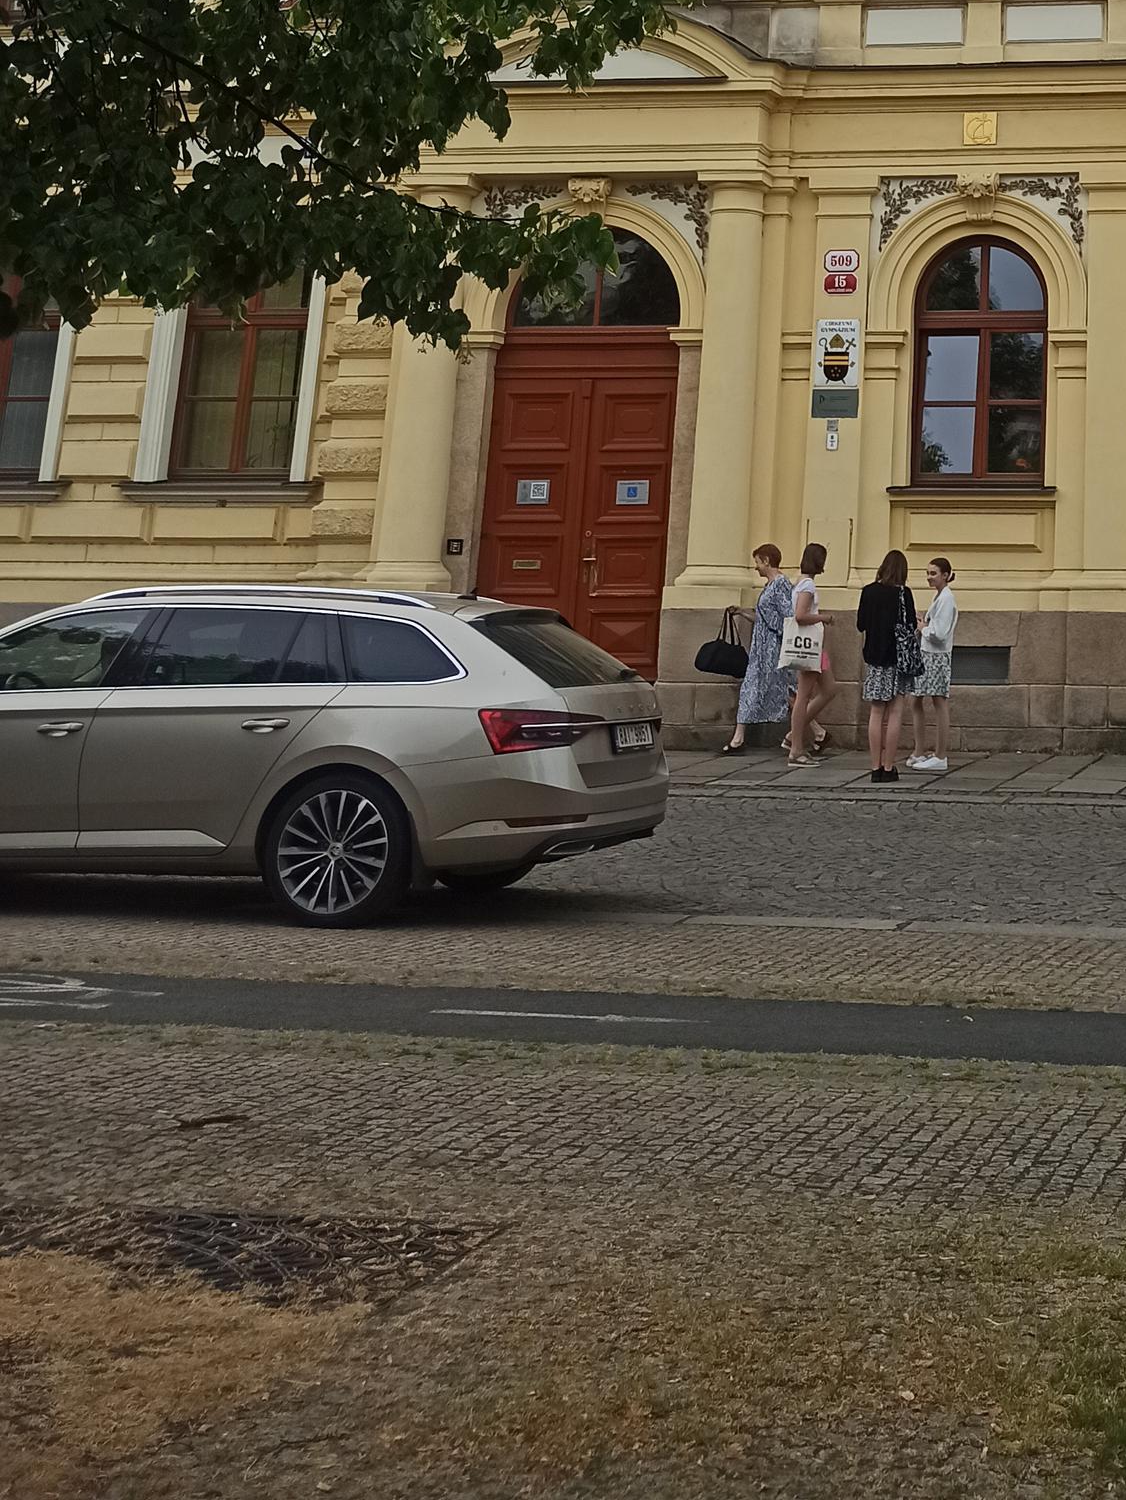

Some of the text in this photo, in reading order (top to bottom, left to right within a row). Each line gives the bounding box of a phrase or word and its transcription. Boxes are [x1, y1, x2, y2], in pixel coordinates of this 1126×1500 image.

[830, 254, 852, 267] 509
[834, 275, 847, 288] 15
[794, 635, 812, 649] CG
